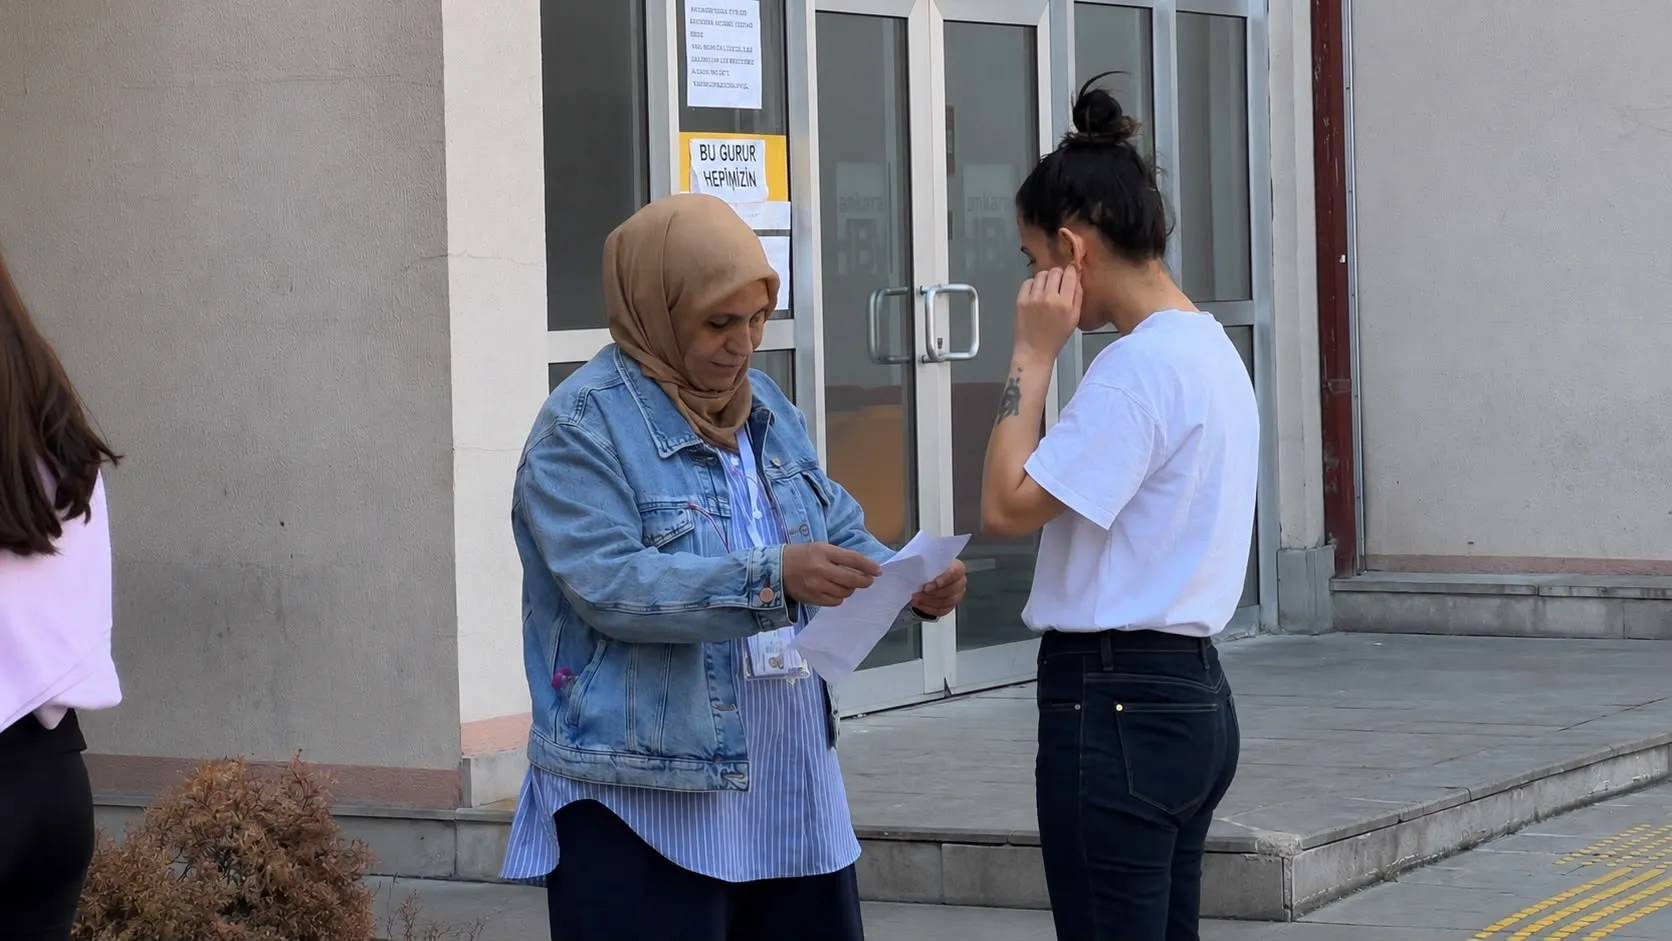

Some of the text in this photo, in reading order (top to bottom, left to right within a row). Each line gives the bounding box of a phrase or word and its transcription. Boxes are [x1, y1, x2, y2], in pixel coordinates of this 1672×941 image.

[700, 144, 757, 162] BU GURUR
[703, 167, 757, 189] HEPİMİZİN
[839, 191, 885, 213] ankara
[967, 191, 1013, 212] ankara
